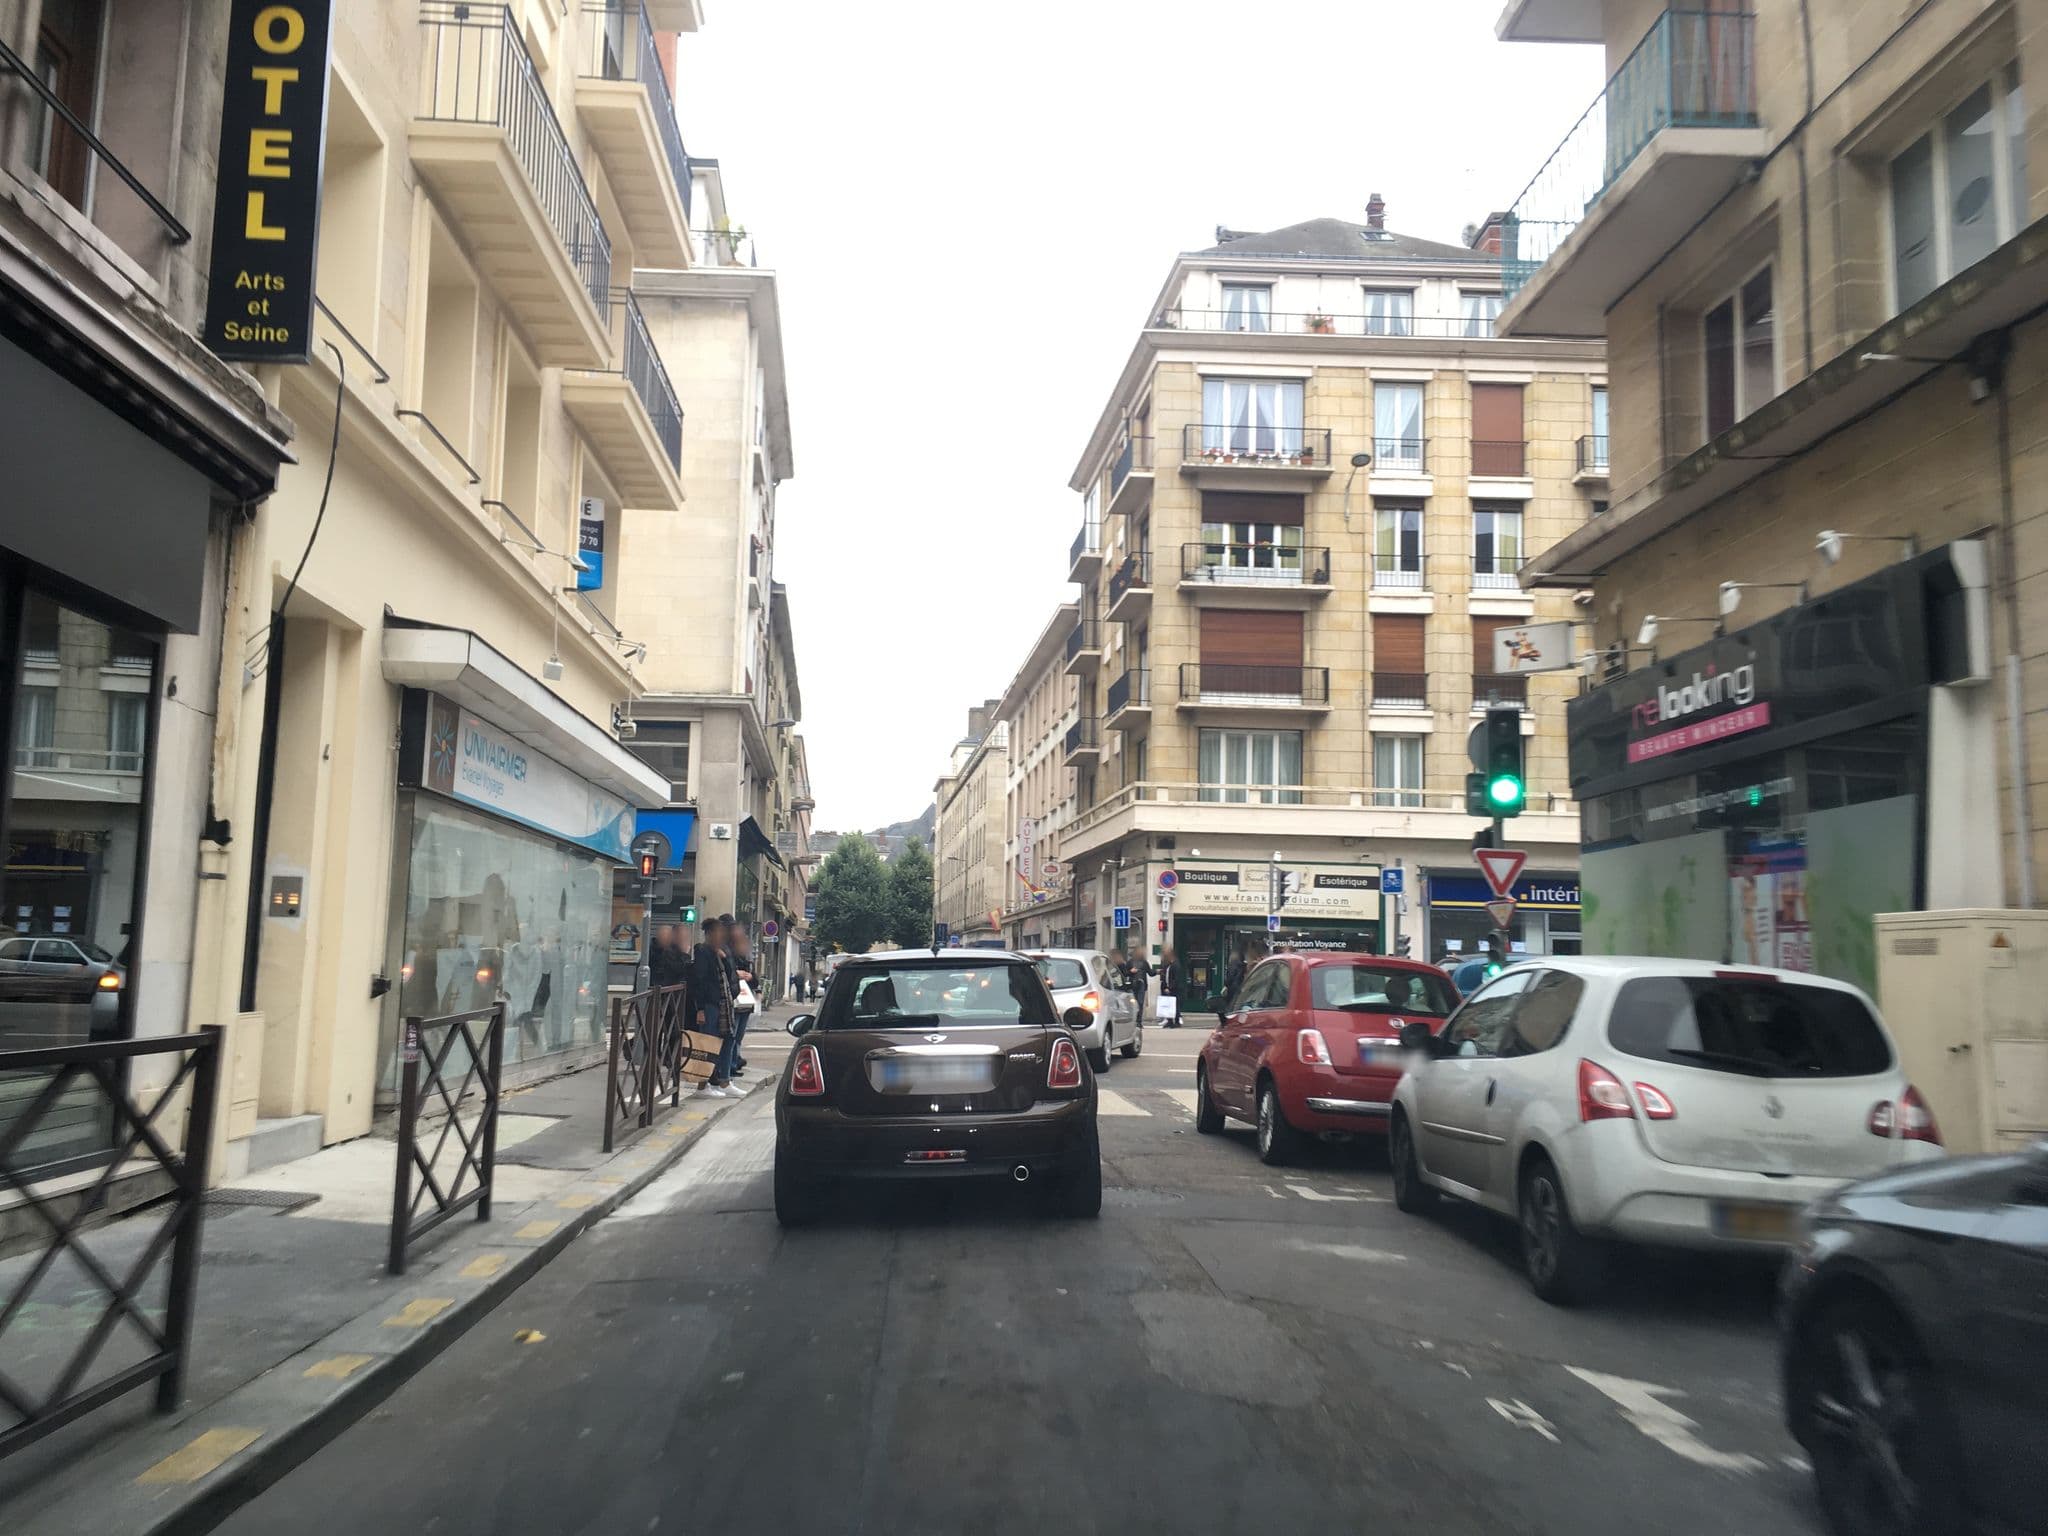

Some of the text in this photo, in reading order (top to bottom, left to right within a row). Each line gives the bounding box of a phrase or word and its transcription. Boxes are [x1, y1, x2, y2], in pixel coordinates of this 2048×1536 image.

[234, 270, 286, 291] Arts
[247, 298, 270, 316] et
[224, 320, 289, 343] Seine
[1632, 662, 1755, 730] relooking
[1023, 820, 1032, 854] AUTO
[1184, 872, 1228, 883] Boutique
[1315, 940, 1347, 949] Voyance
